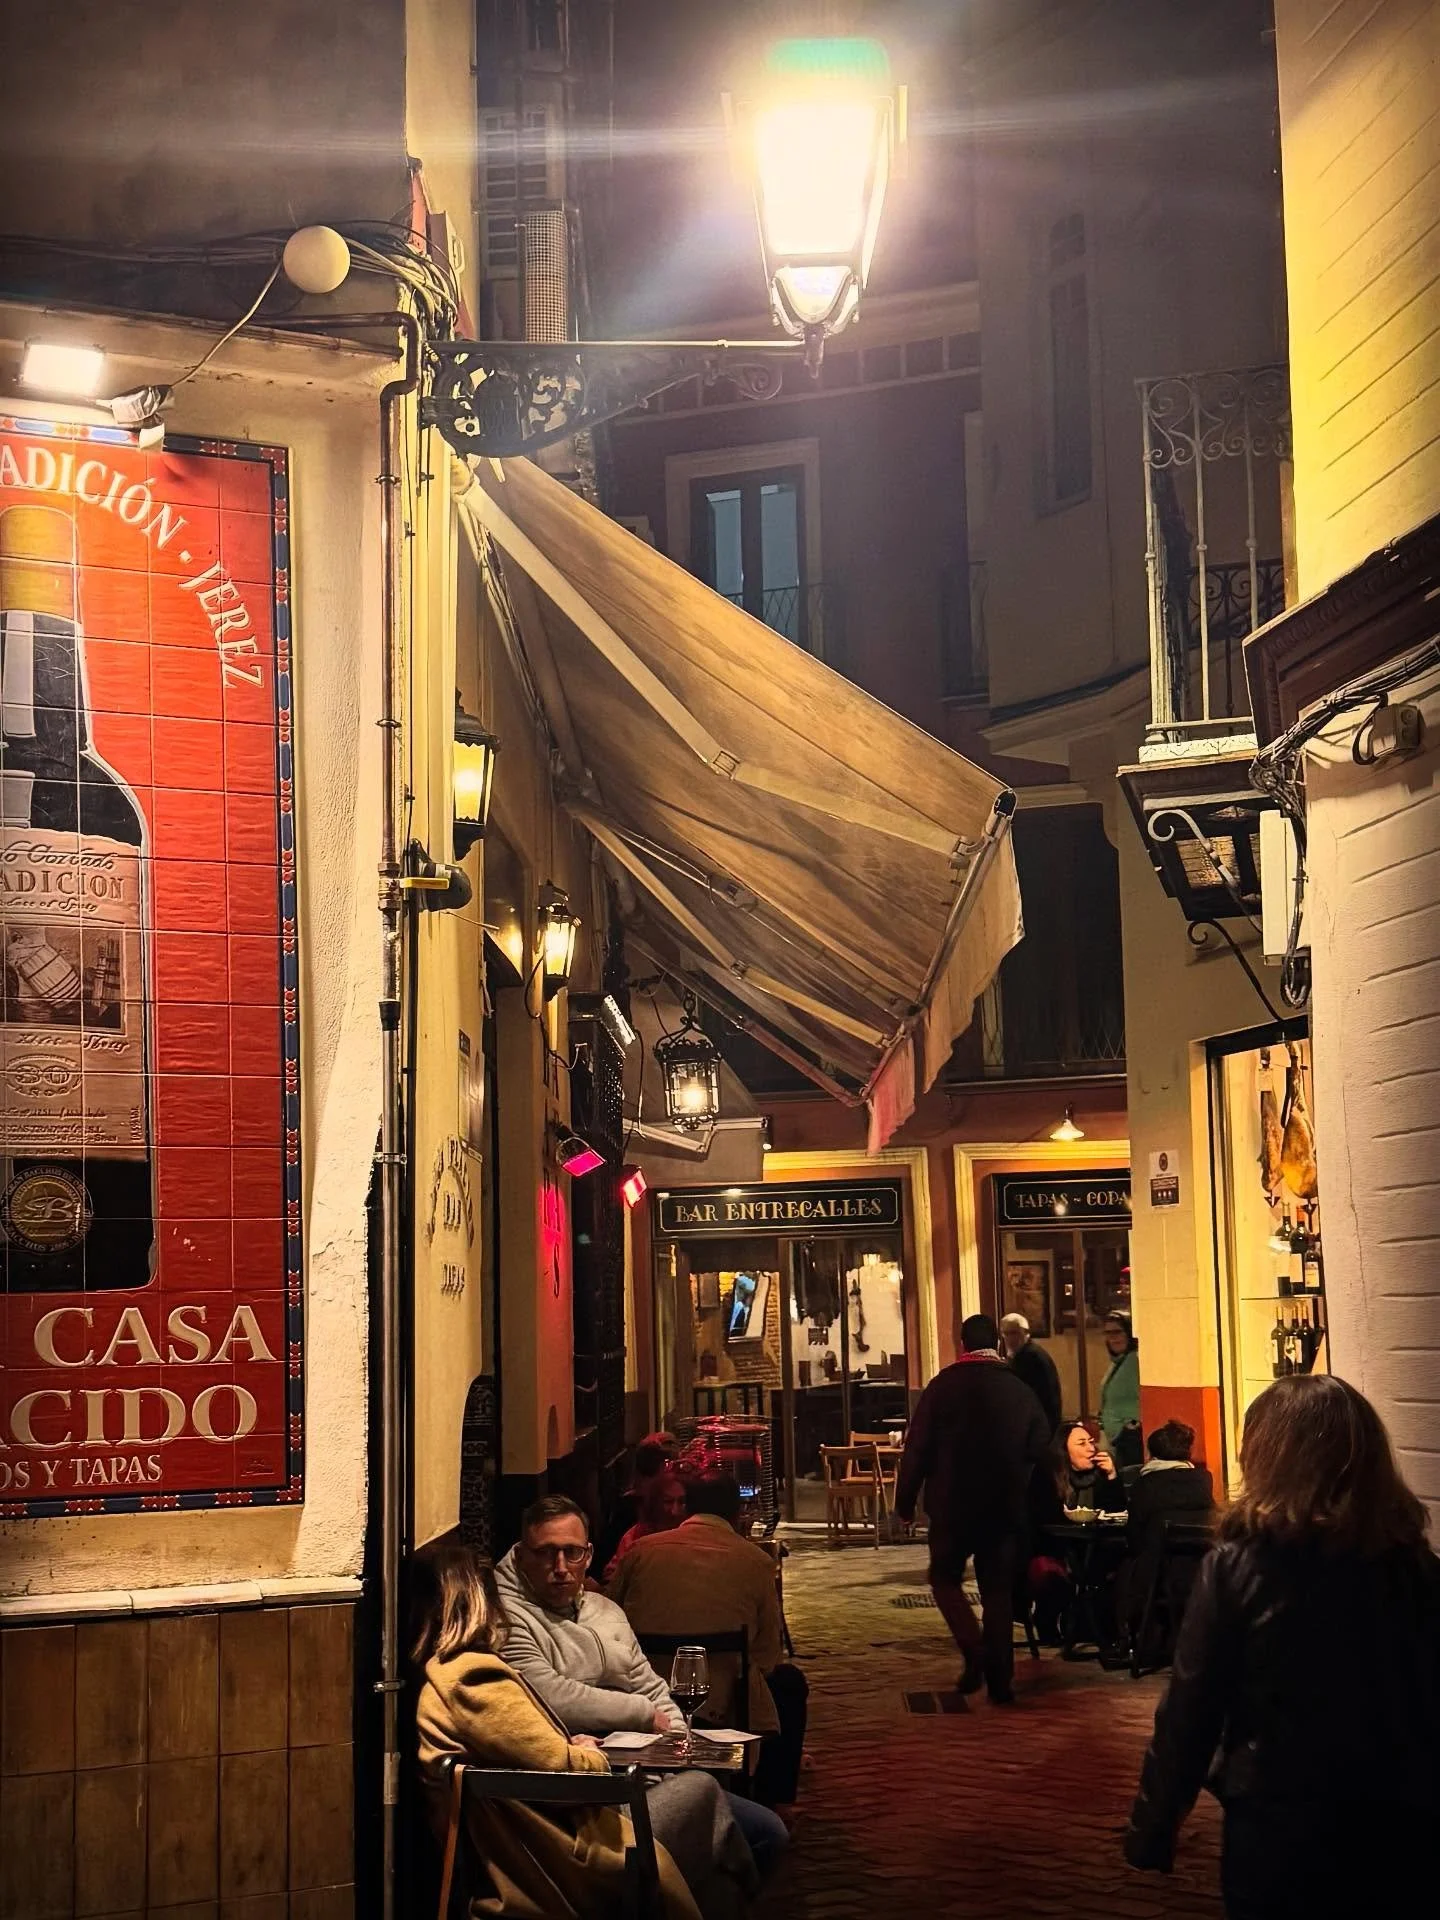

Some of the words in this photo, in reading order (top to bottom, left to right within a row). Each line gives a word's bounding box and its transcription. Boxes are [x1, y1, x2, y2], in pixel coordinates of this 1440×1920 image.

[675, 1205, 719, 1223] BAR
[725, 1198, 882, 1222] ENTRECALLES
[1015, 1192, 1069, 1209] TAPAS
[33, 1305, 277, 1368] CASA
[0, 1384, 258, 1450] CIDO
[40, 1460, 62, 1489] Y
[69, 1454, 163, 1487] TAPAS
